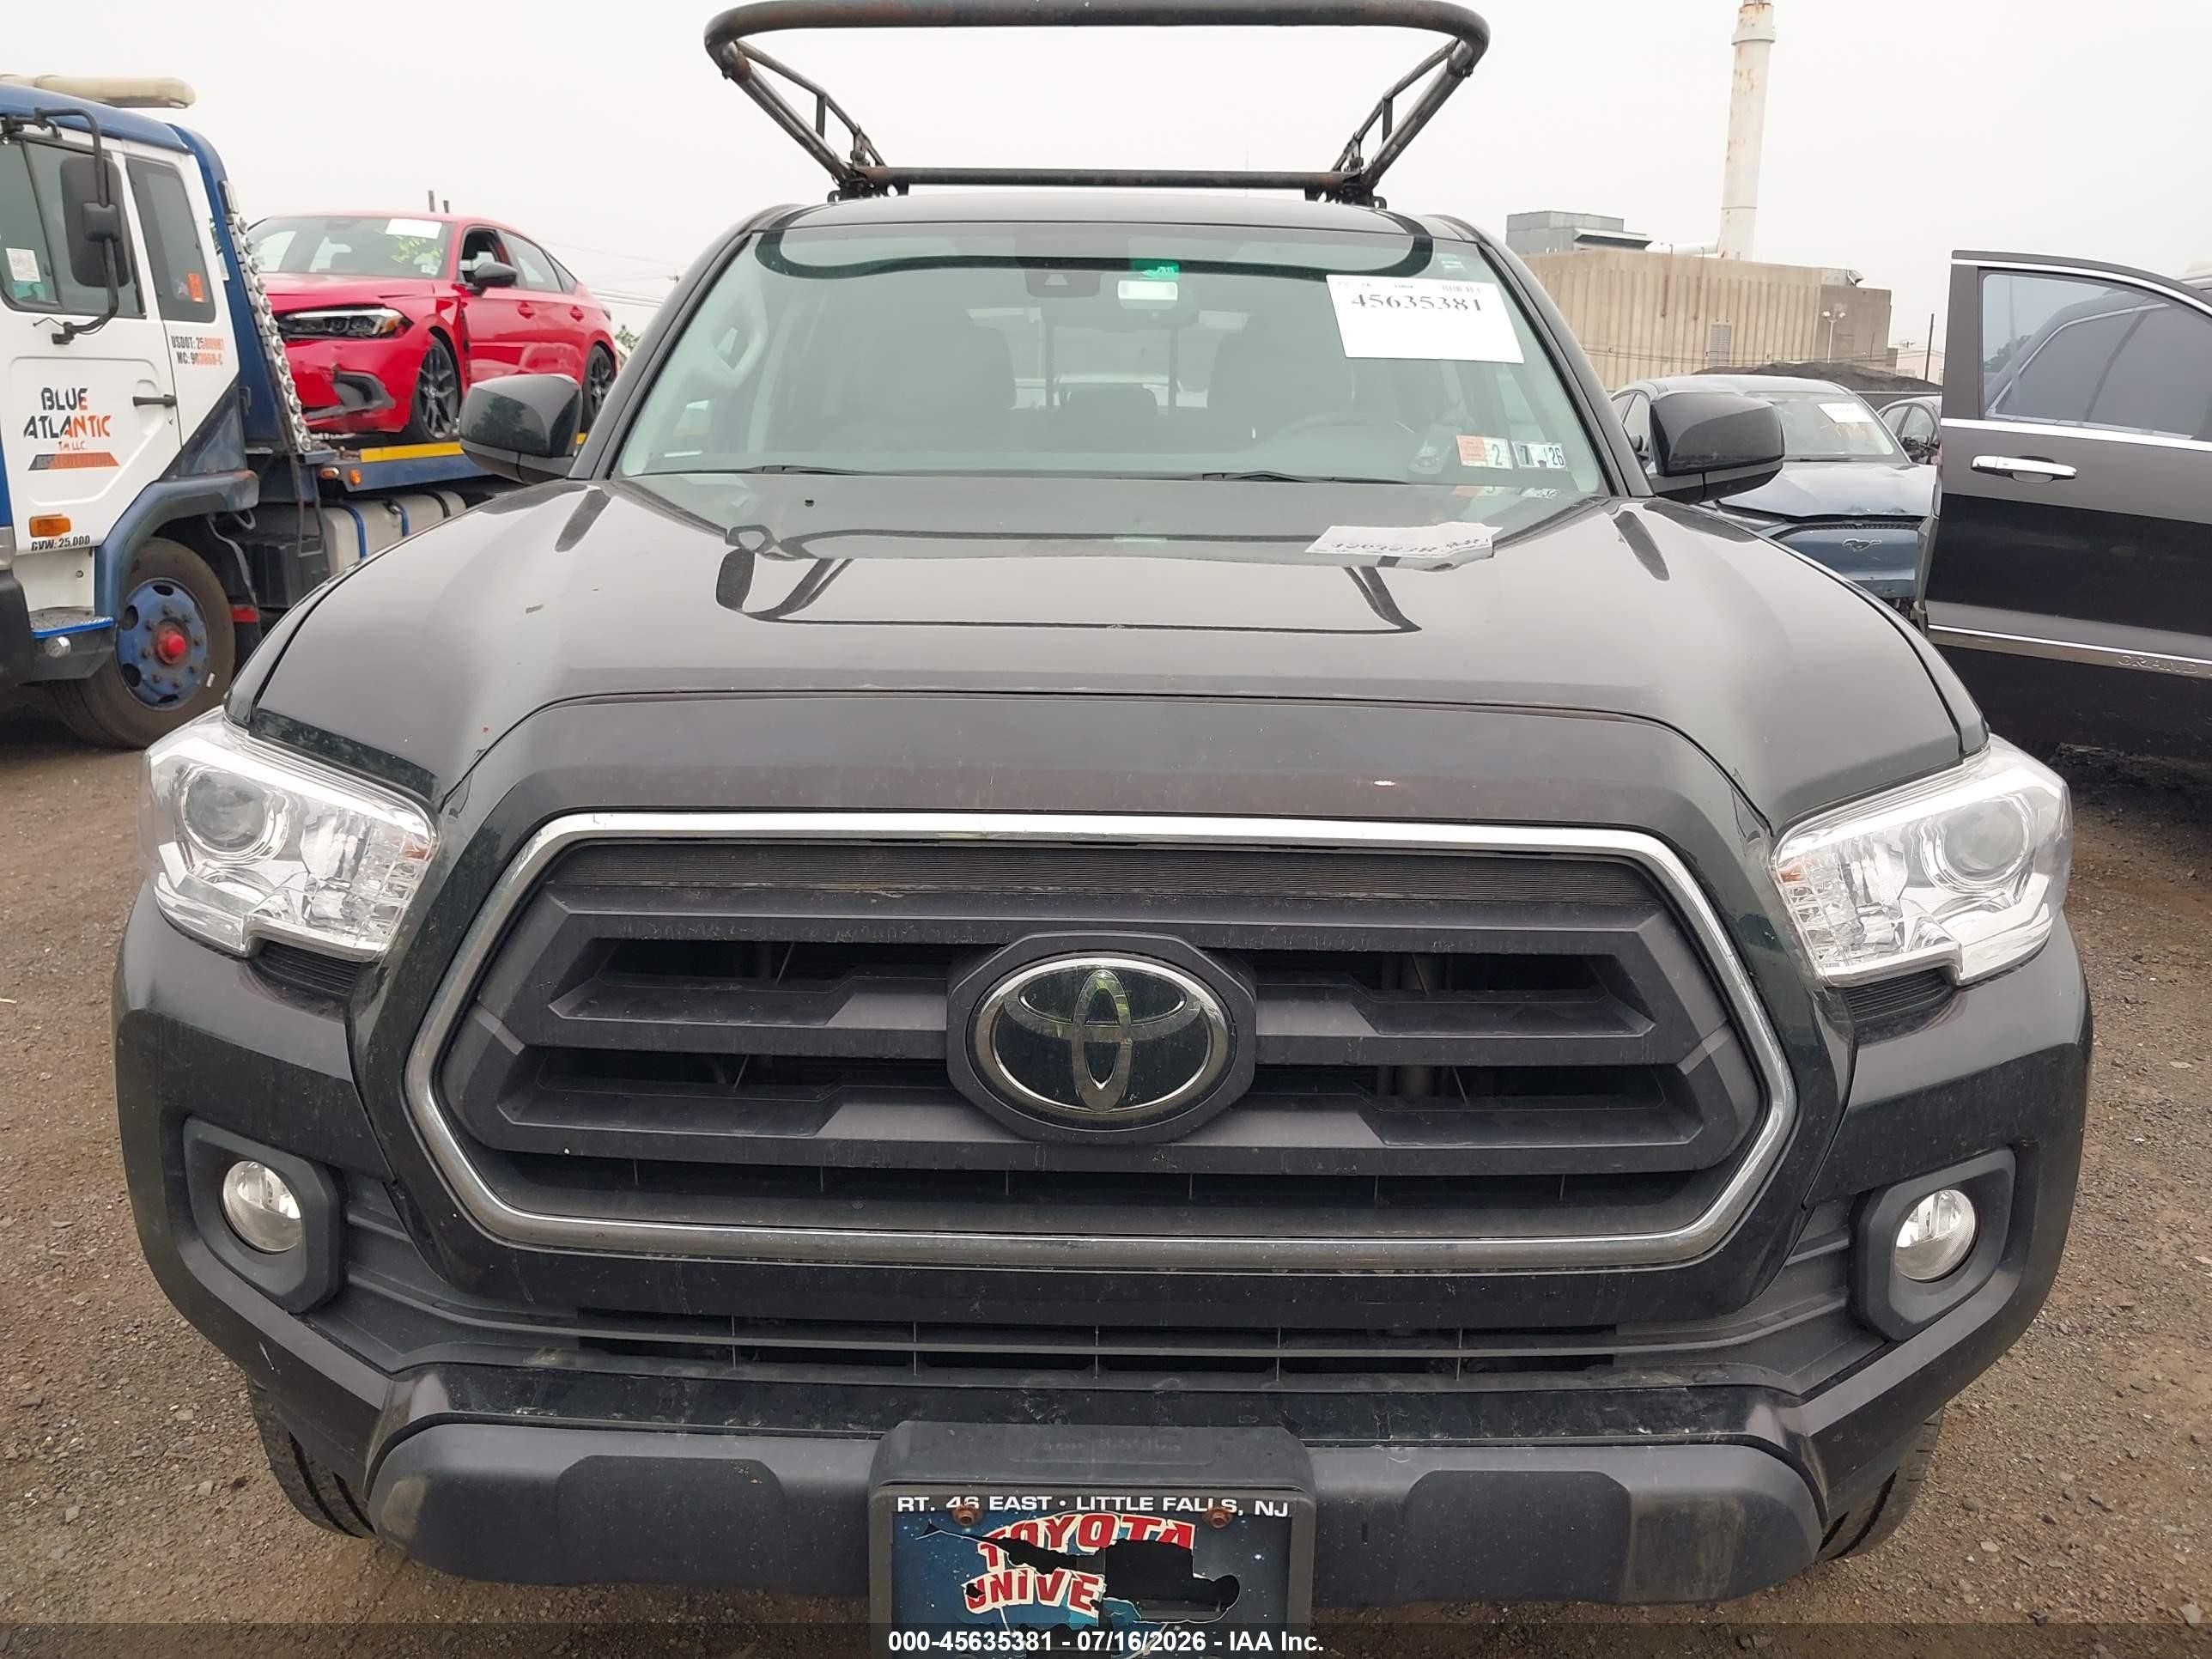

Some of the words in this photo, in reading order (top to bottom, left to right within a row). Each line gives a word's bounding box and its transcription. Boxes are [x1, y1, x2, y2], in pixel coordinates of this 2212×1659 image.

[1352, 294, 1482, 312] 45635381
[41, 387, 88, 410] BLUE
[23, 415, 111, 439] ATLANTIC
[1492, 443, 1503, 466] 2
[1548, 447, 1565, 465] 26
[897, 1497, 936, 1512] RT.
[945, 1496, 980, 1510] 46
[989, 1496, 1053, 1511] EAST
[1076, 1496, 1154, 1511] LITTLE
[1255, 1500, 1288, 1518] NJ
